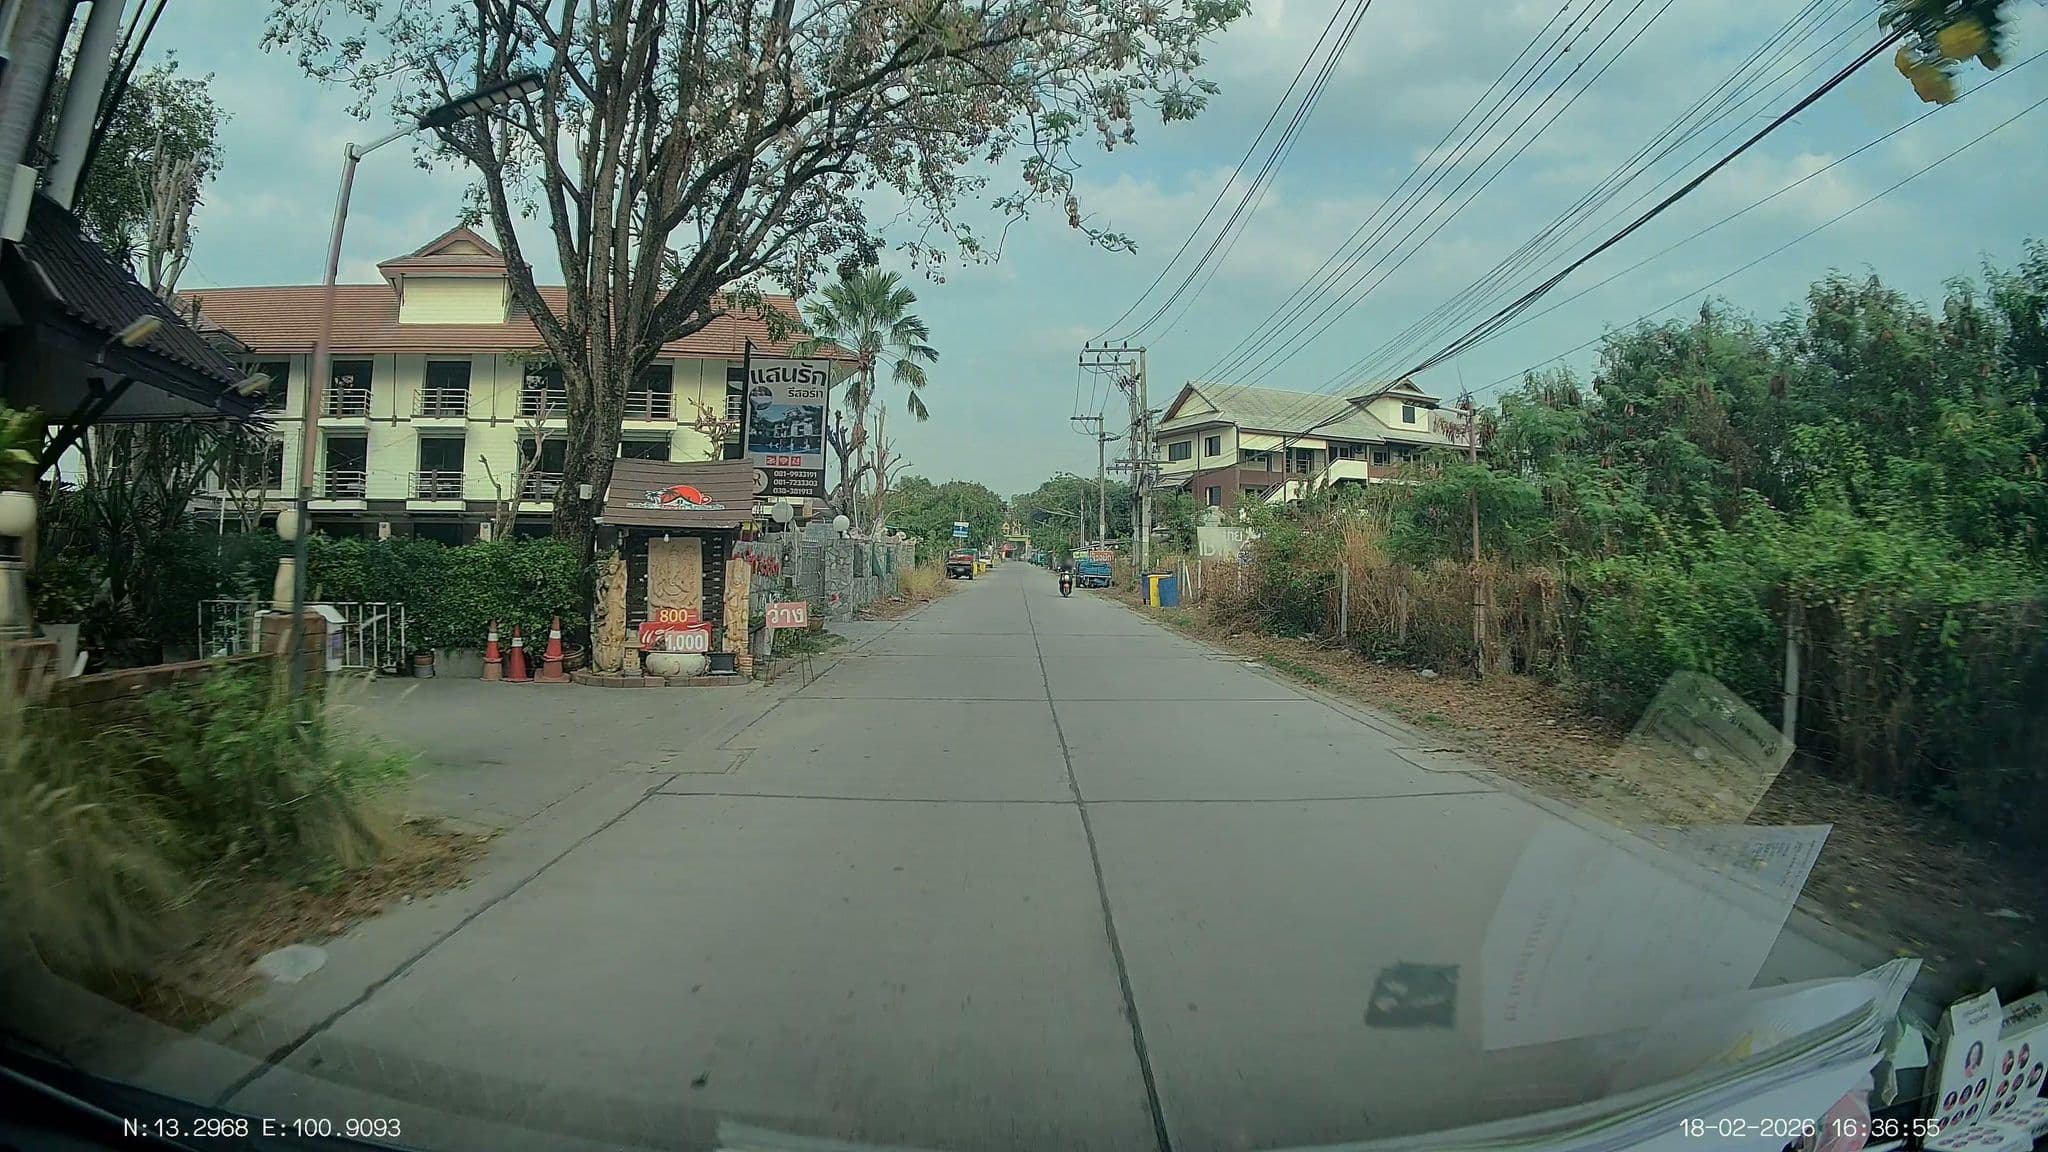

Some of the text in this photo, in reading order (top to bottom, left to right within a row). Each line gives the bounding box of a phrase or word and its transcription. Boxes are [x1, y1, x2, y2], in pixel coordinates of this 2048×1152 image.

[750, 362, 827, 386] แสนรัก
[767, 603, 804, 624] ว่าง
